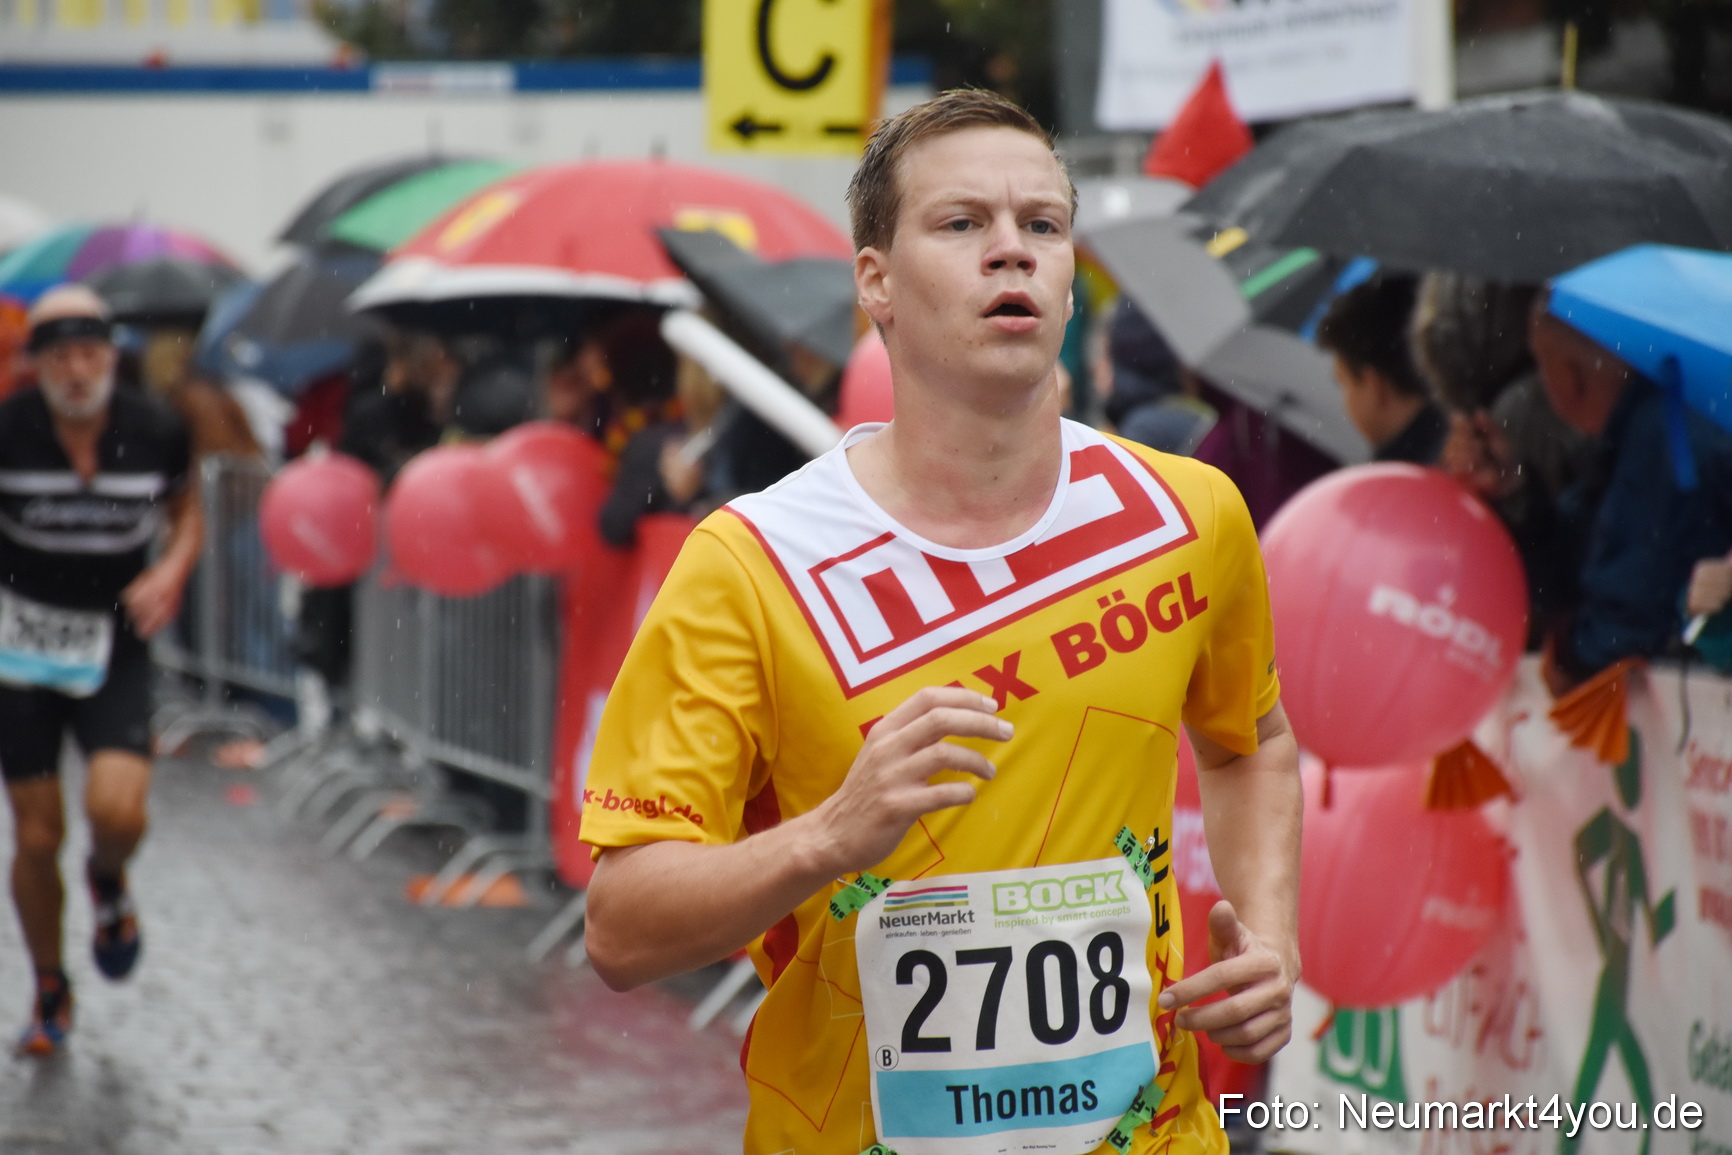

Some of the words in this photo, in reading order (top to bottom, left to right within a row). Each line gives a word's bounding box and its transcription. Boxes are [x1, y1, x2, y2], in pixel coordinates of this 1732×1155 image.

[1050, 572, 1209, 679] BÖGL
[991, 870, 1129, 916] BOCK
[879, 910, 975, 929] NeuerMarkt
[886, 930, 917, 940] einkaufen
[920, 929, 938, 937] leben
[994, 915, 1039, 929] inspired
[1042, 914, 1054, 925] by
[1057, 911, 1087, 922] smart
[1090, 906, 1131, 918] concepts
[895, 931, 1131, 1053] 2708
[882, 1049, 893, 1067] B
[946, 1079, 1099, 1125] Thomas
